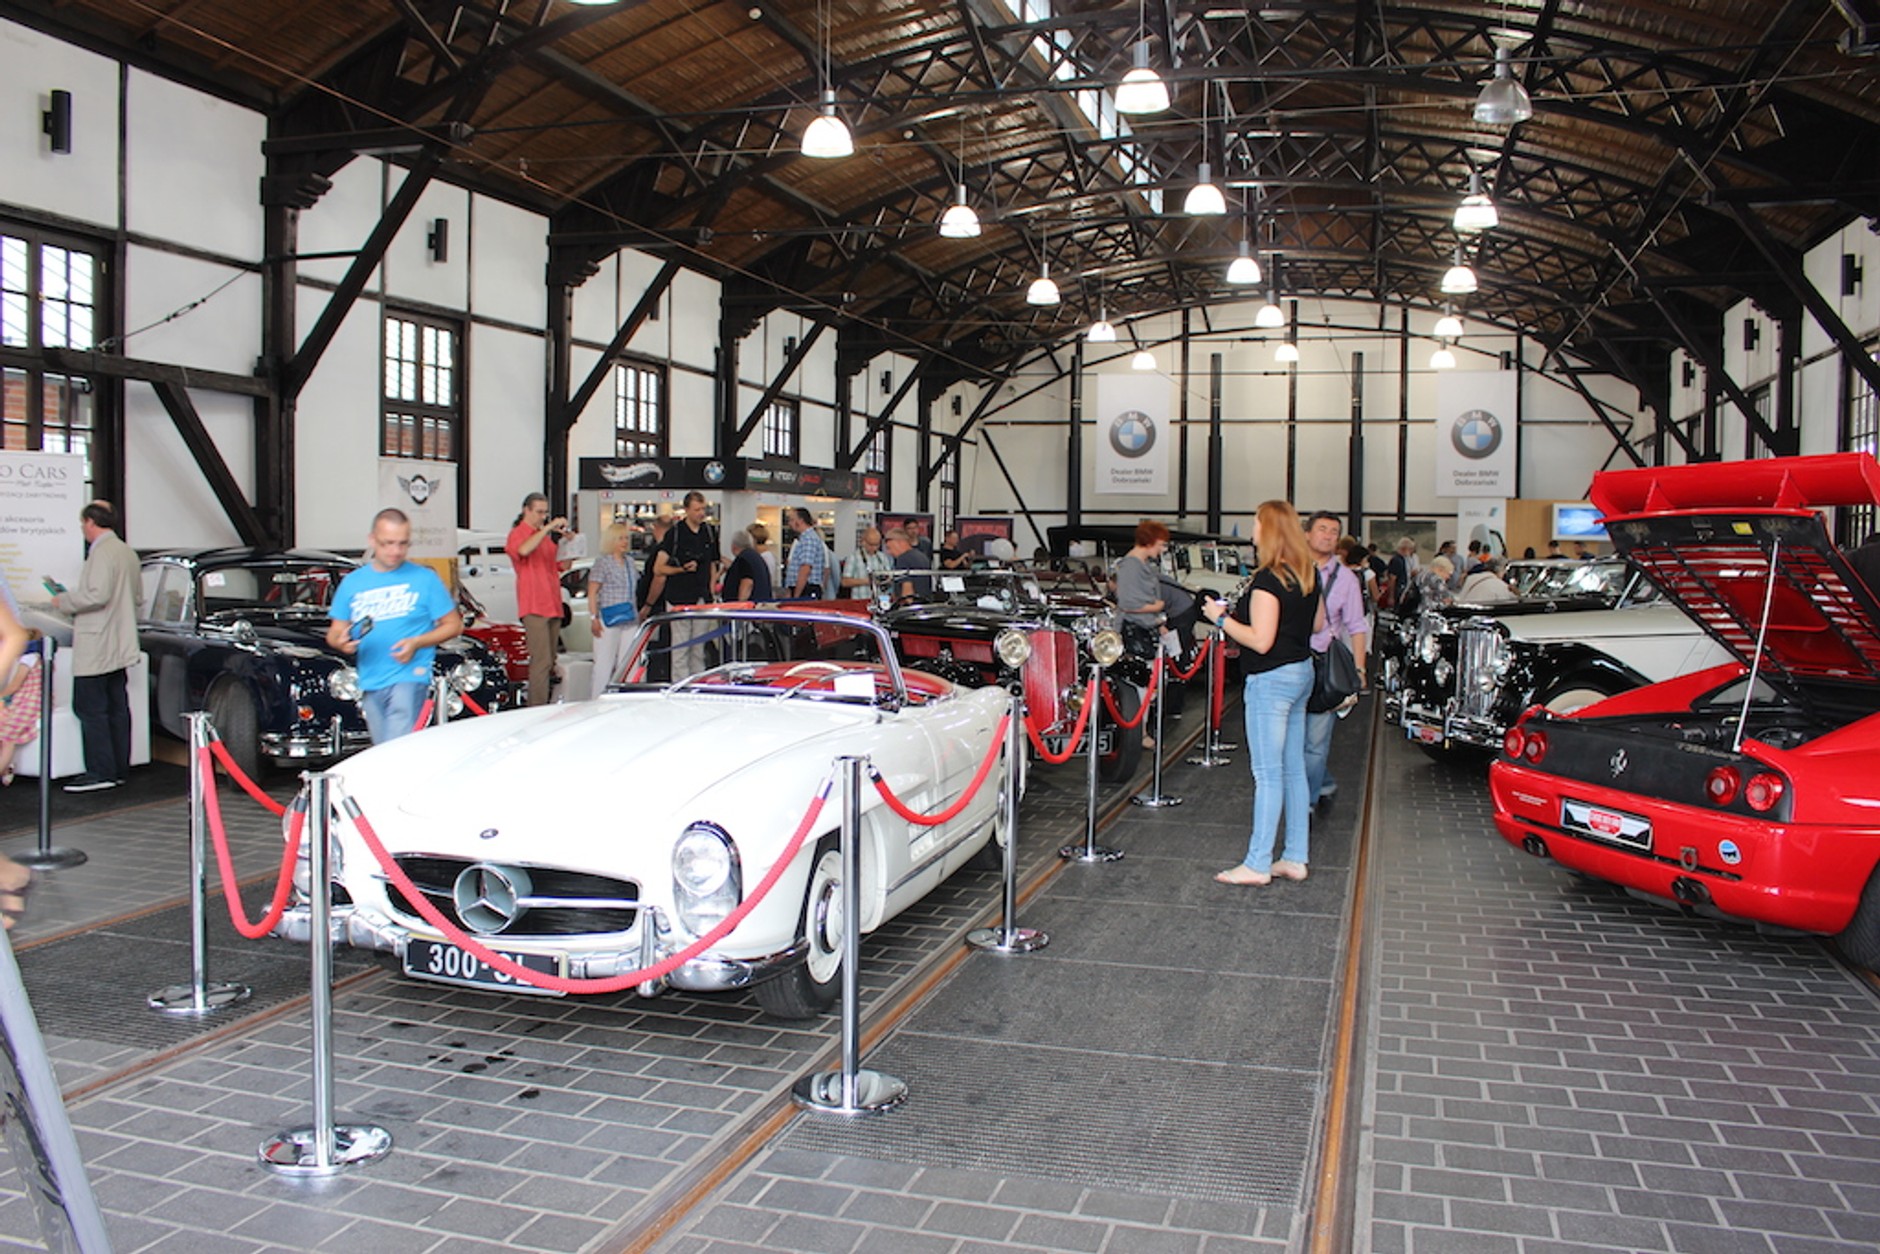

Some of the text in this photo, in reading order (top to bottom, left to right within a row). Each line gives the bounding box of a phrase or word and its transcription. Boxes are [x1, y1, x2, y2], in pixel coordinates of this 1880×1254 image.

[1114, 411, 1152, 428] BMW
[1456, 410, 1498, 428] BMW
[1110, 468, 1154, 476] Dealer BMW
